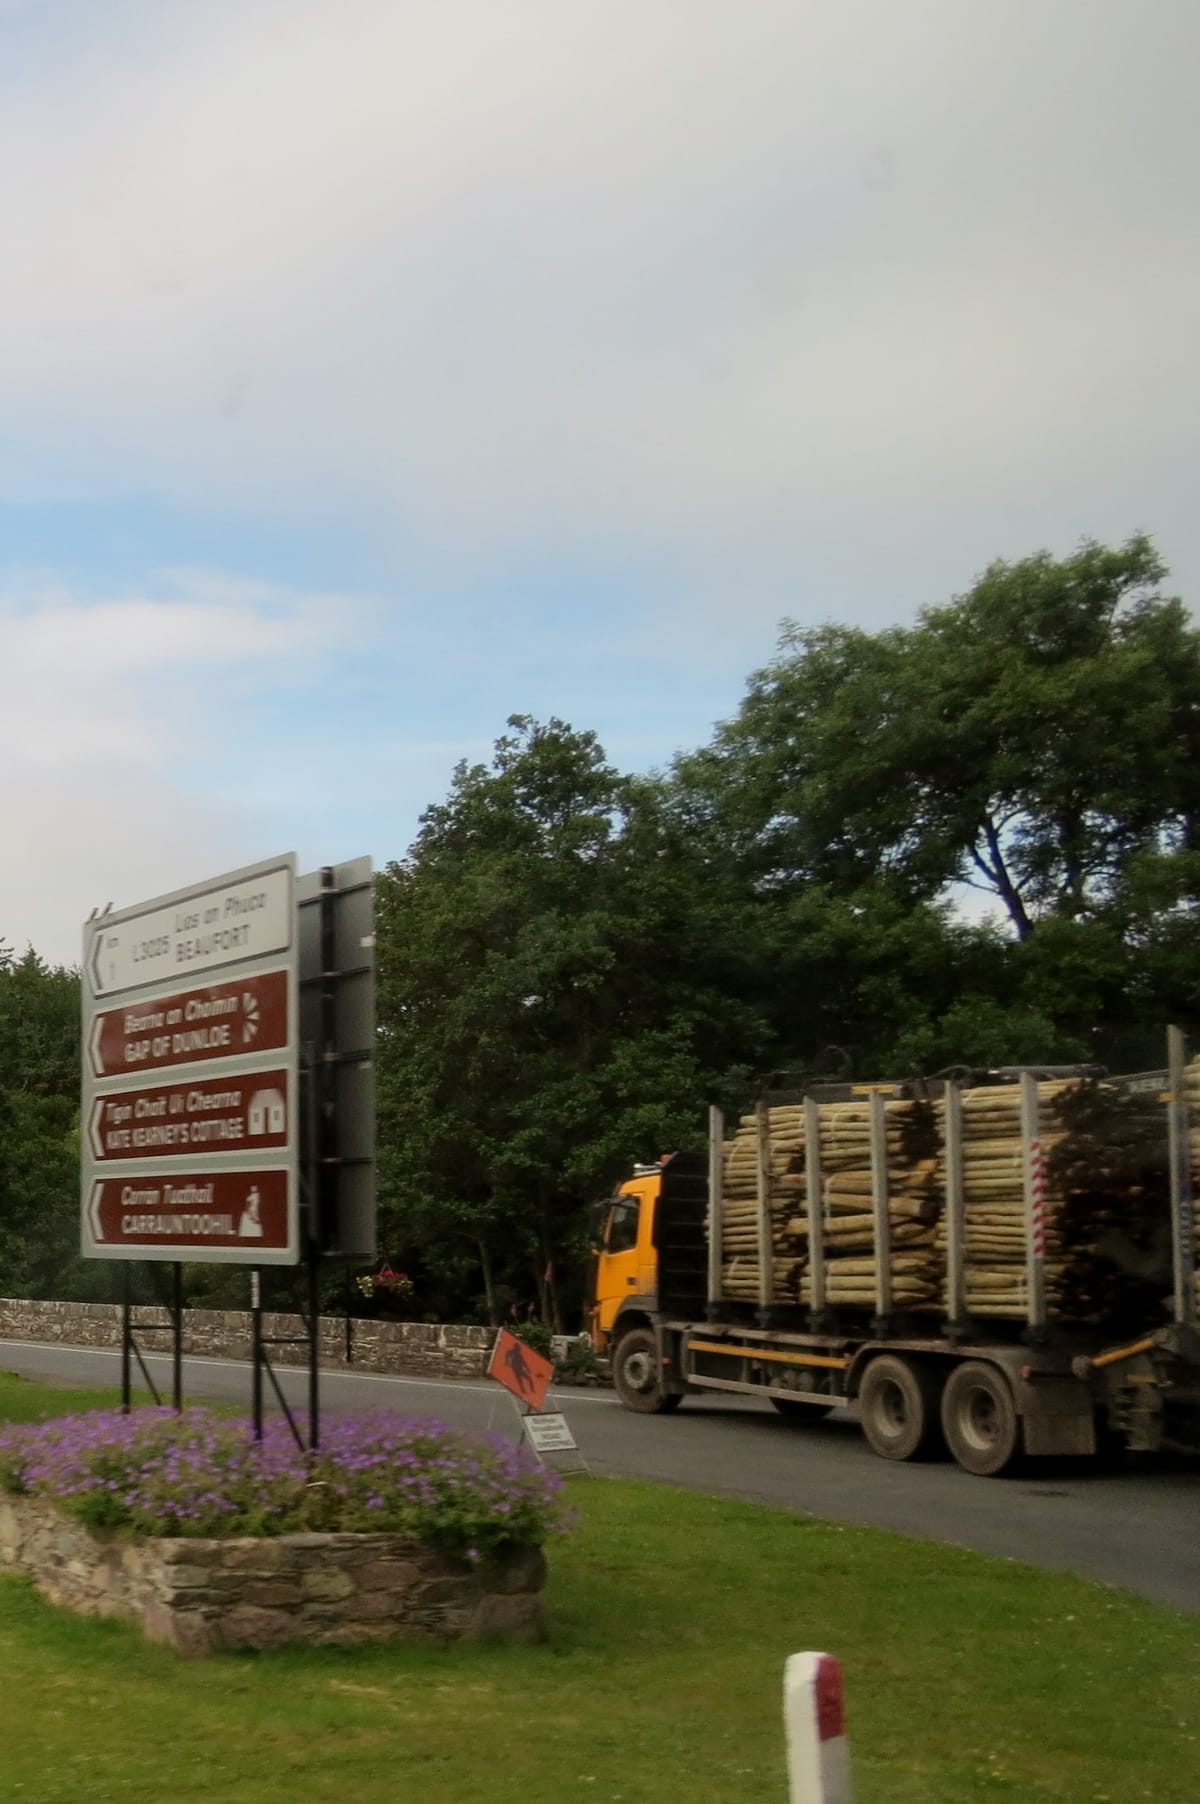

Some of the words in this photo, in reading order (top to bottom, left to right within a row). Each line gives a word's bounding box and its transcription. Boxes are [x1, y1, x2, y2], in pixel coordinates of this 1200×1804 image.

[175, 924, 251, 962] BEAUFORT
[123, 1012, 165, 1035] Bearna
[166, 1008, 183, 1025] an
[124, 1039, 151, 1063] GAP
[151, 1035, 172, 1058] OF
[172, 1024, 231, 1054] DUNLOE
[106, 1129, 131, 1150] KATE
[131, 1123, 190, 1147] KEARNEY'S
[190, 1117, 245, 1143] COTTAGE
[120, 1213, 238, 1236] CARRAUNTOOHIL
